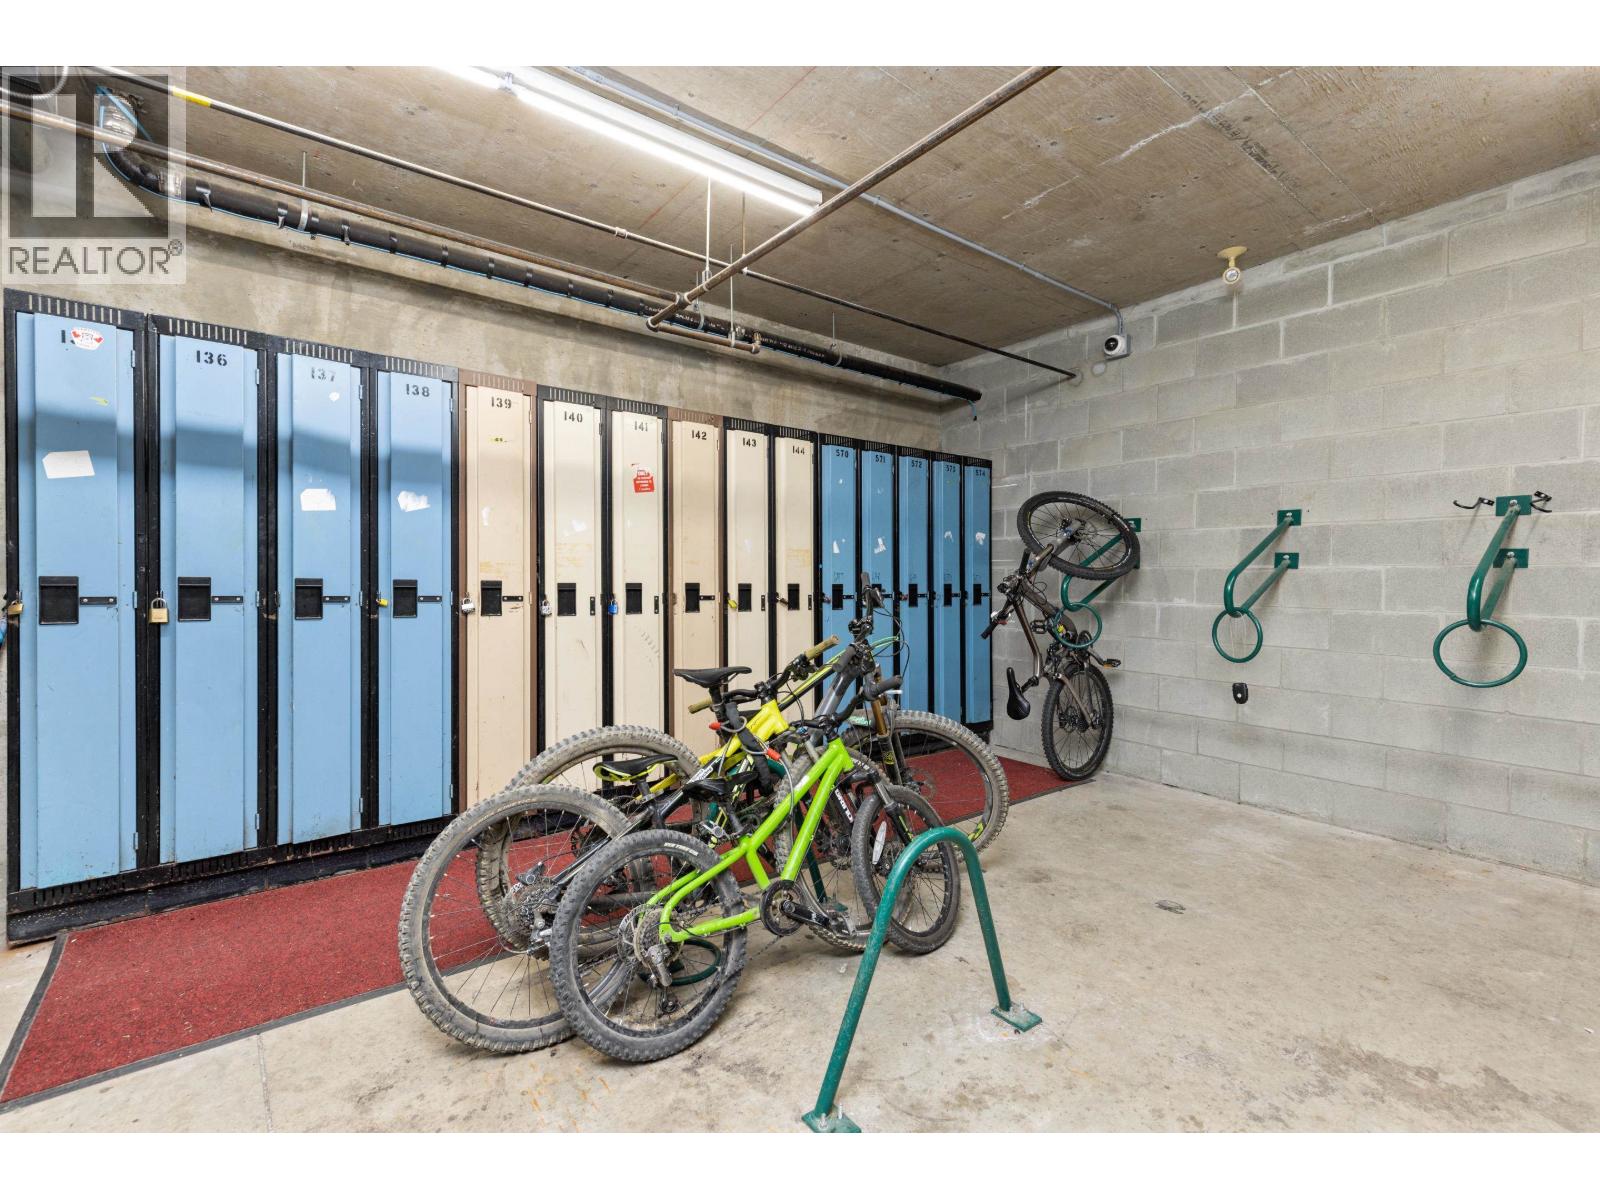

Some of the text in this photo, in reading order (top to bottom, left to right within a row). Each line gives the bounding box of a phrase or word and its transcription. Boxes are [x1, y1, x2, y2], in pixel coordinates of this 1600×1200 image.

[196, 350, 228, 367] 136
[311, 367, 336, 382] 137
[406, 383, 430, 398] 138
[490, 396, 512, 409] 139
[564, 411, 583, 423] 140
[634, 421, 649, 432] 141
[691, 430, 707, 441] 142
[742, 437, 757, 448] 143
[792, 445, 805, 456] 144
[836, 448, 849, 458] 570
[875, 454, 886, 464] 571
[911, 460, 922, 469] 572
